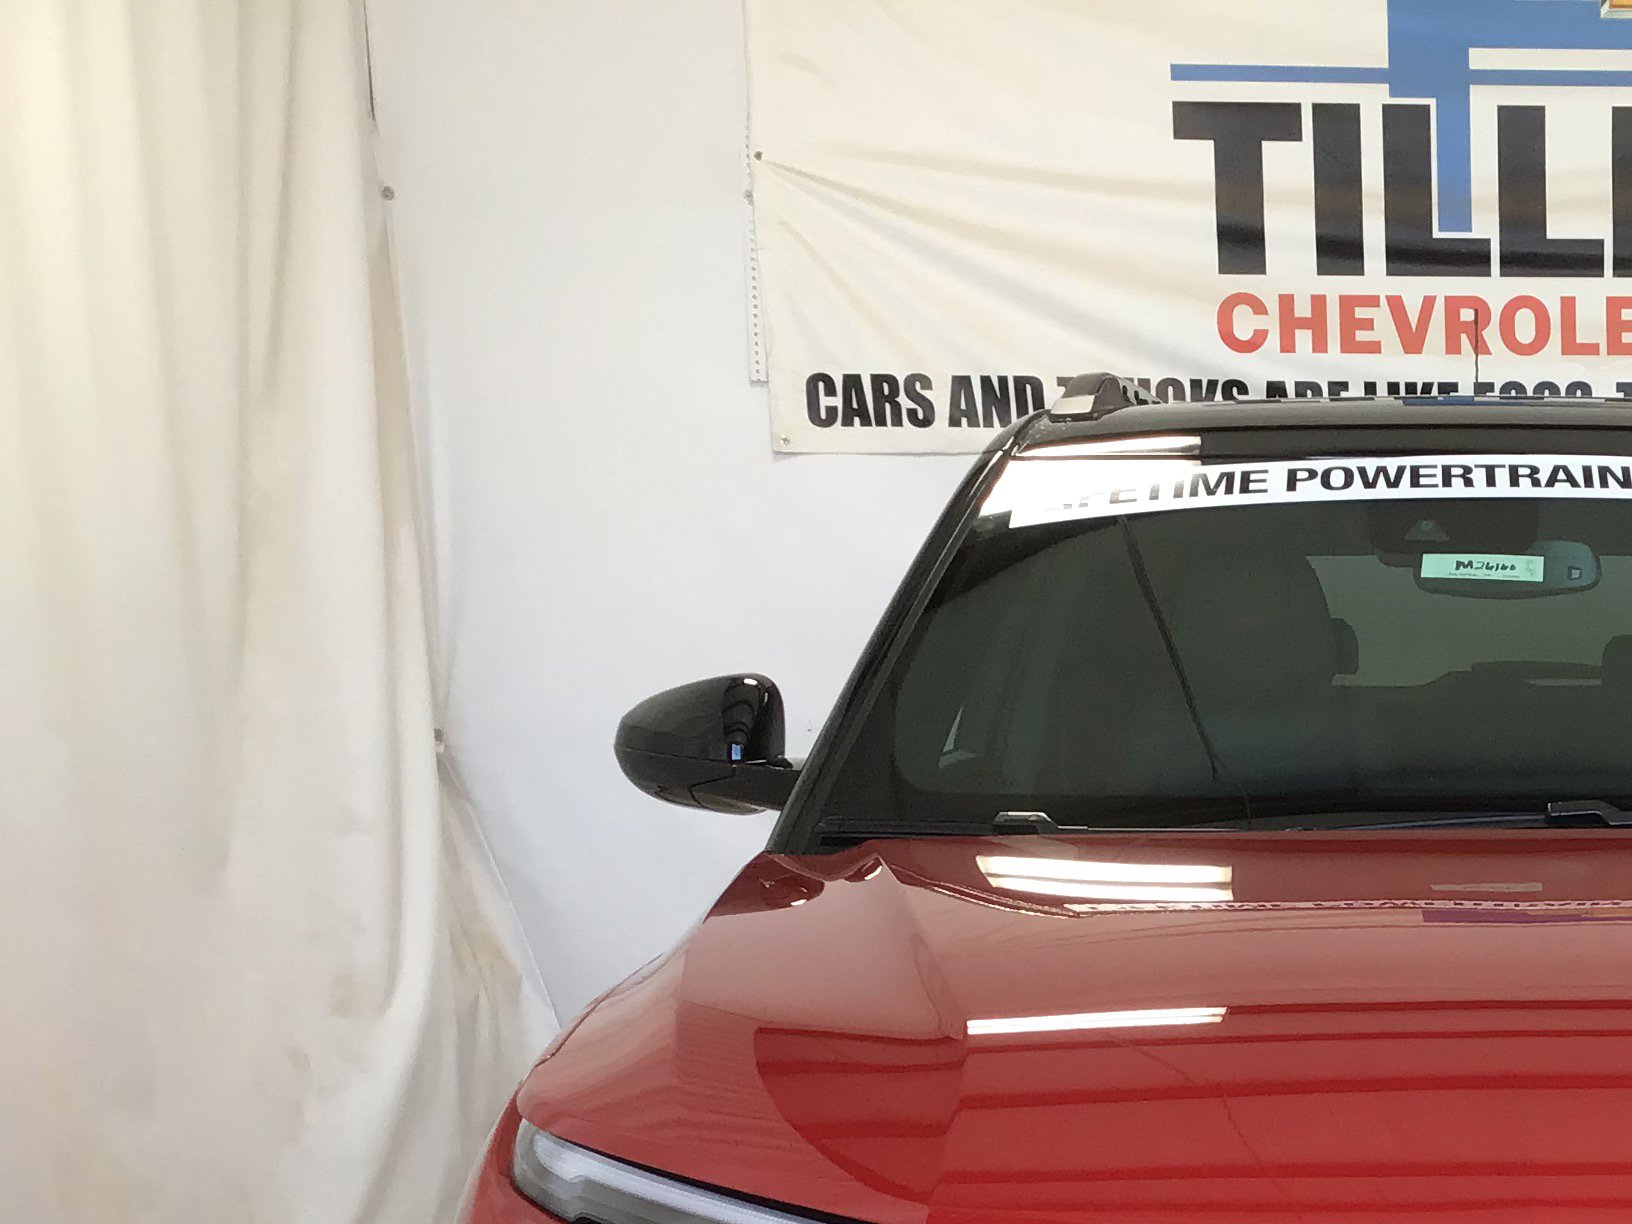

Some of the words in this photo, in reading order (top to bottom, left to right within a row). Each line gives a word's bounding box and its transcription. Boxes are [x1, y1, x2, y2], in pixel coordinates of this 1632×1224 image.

[806, 372, 936, 429] CARS
[948, 374, 1046, 428] AND
[1286, 464, 1632, 493] POWERTRAIN
